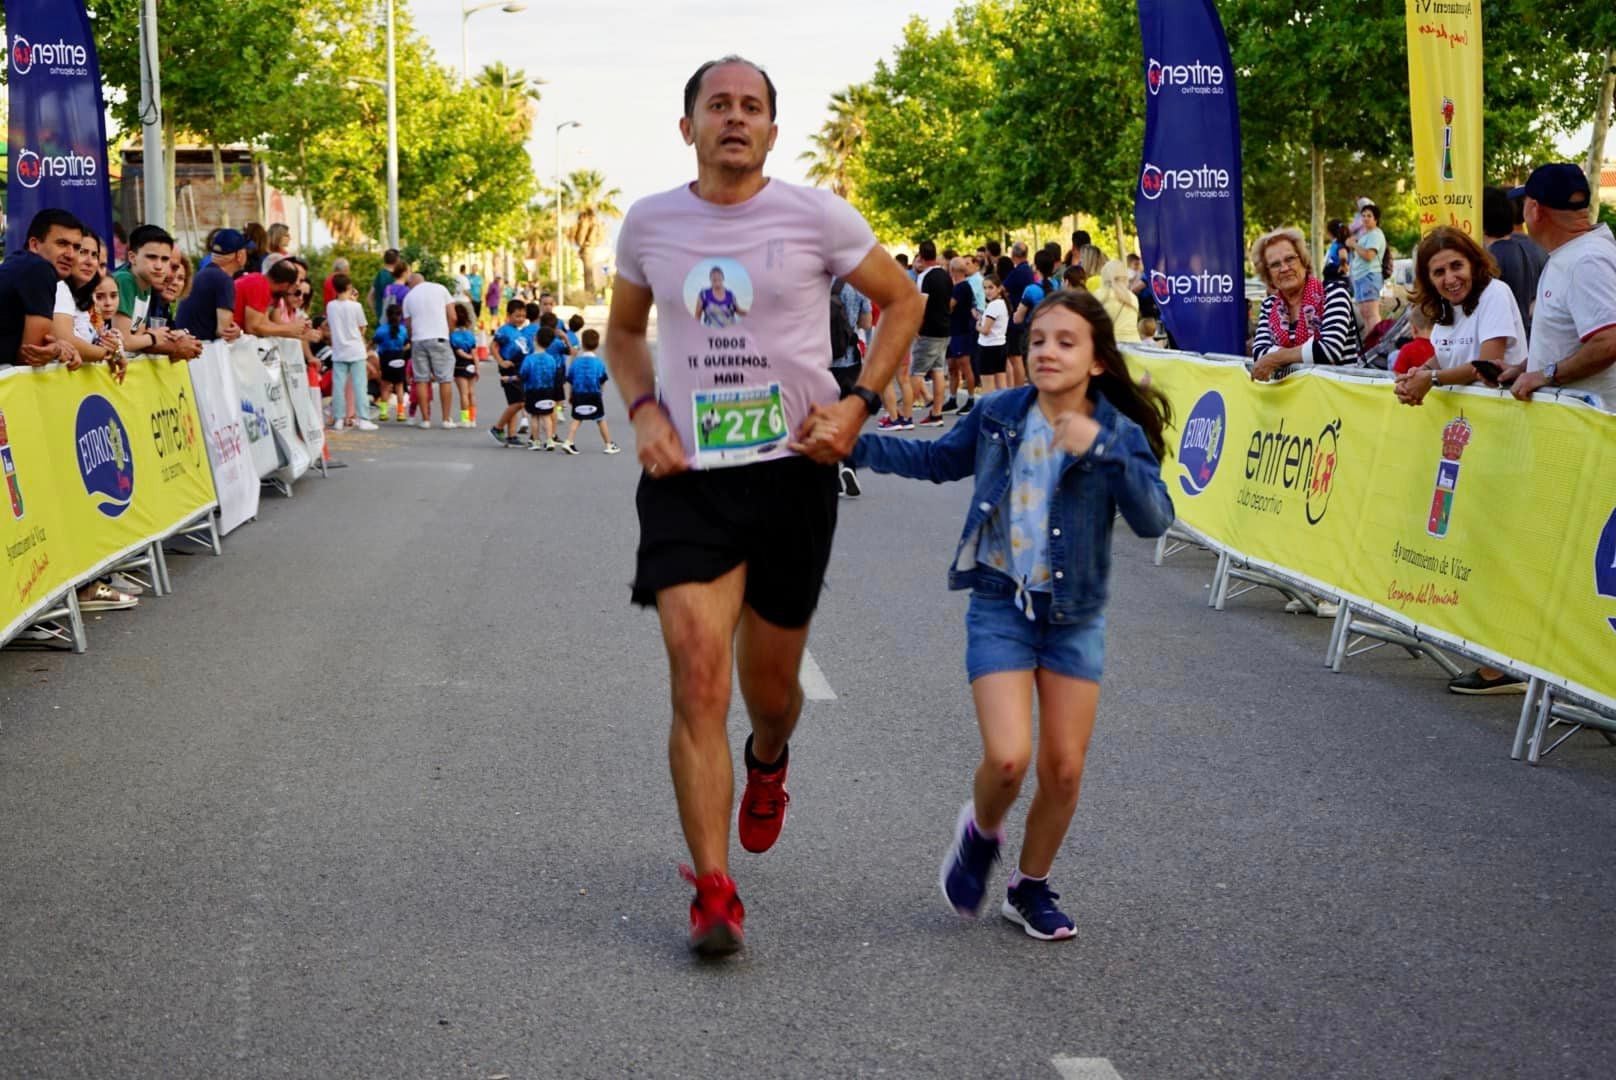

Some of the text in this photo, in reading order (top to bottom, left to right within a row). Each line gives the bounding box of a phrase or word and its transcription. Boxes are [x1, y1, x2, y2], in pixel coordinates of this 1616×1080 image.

[709, 337, 746, 350] TODOS
[688, 356, 699, 368] TE
[714, 373, 744, 385] MARI
[724, 404, 782, 443] 276
[1439, 556, 1449, 575] de
